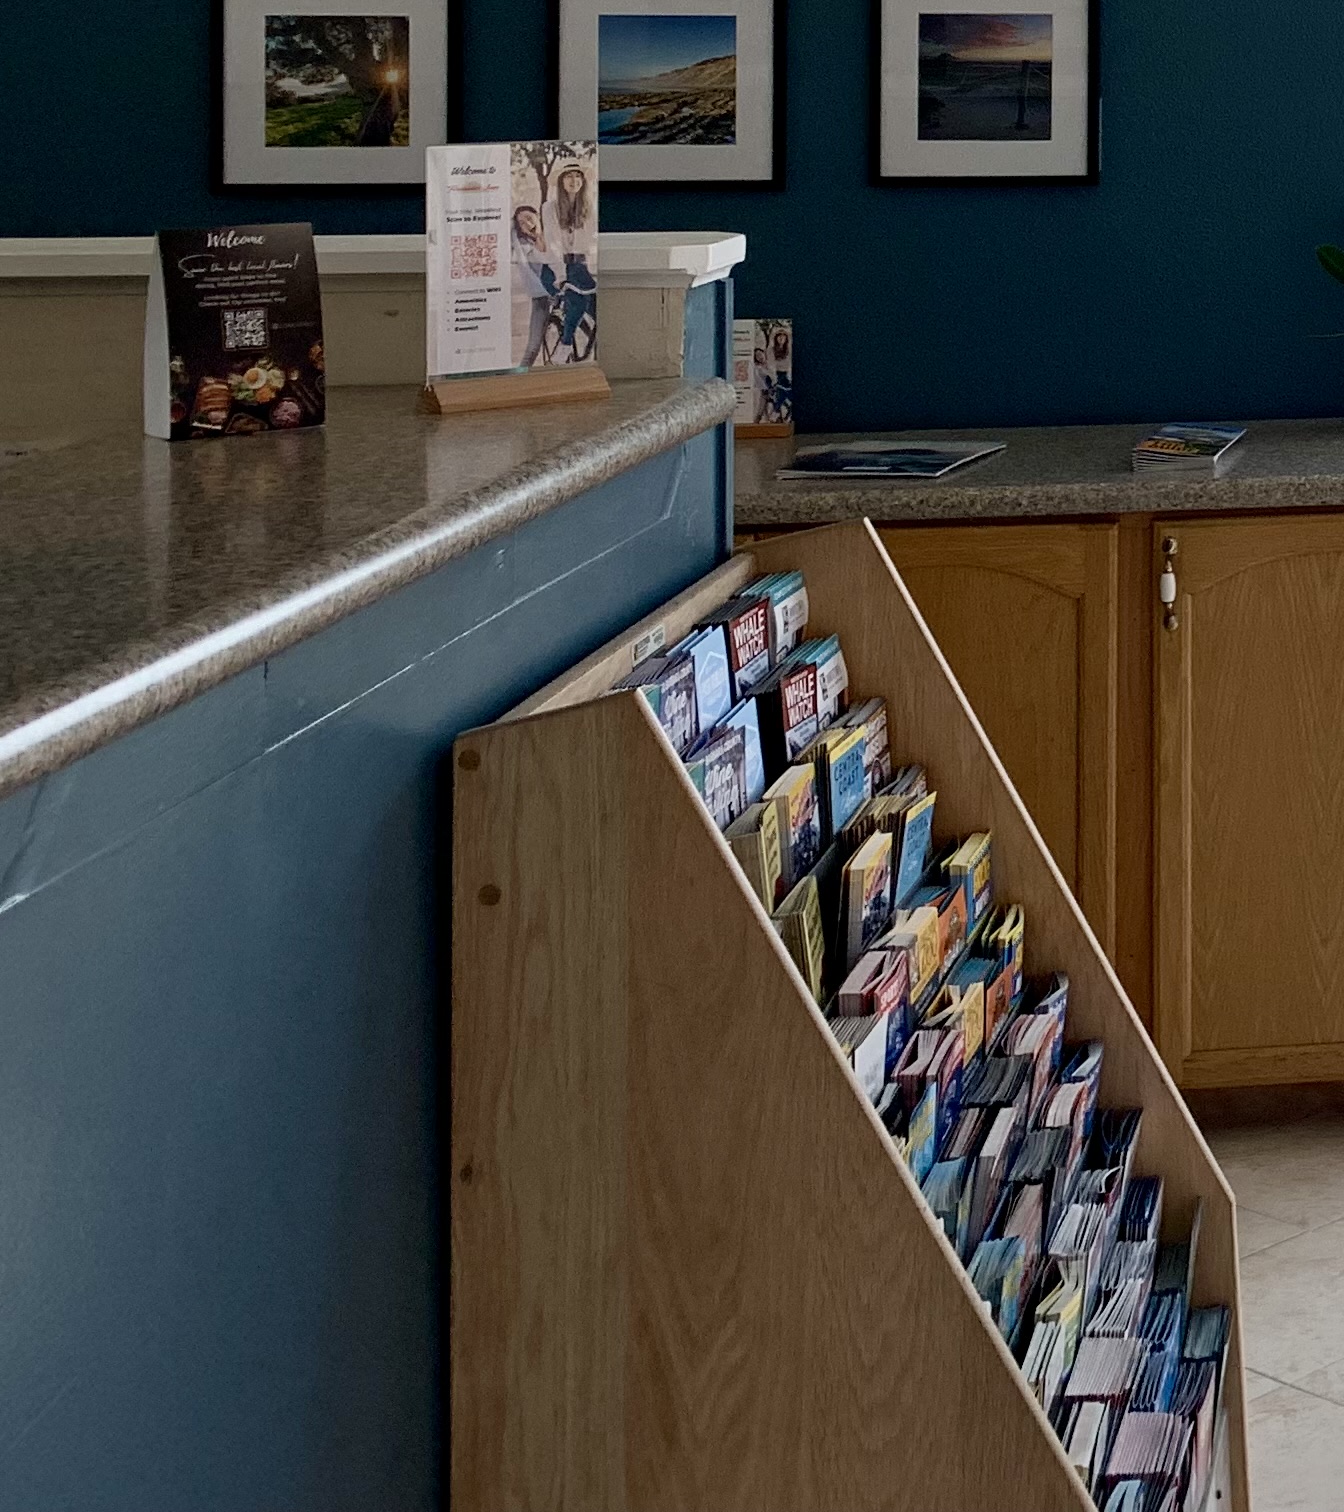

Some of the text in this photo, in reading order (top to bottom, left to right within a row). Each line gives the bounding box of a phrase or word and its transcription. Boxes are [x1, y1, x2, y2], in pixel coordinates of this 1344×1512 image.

[451, 165, 487, 176] Welcome
[206, 230, 266, 248] Welcome
[733, 608, 765, 648] WHALE
[737, 631, 765, 668] WATCH
[784, 672, 815, 709] WHALE
[787, 696, 814, 728] WATCH
